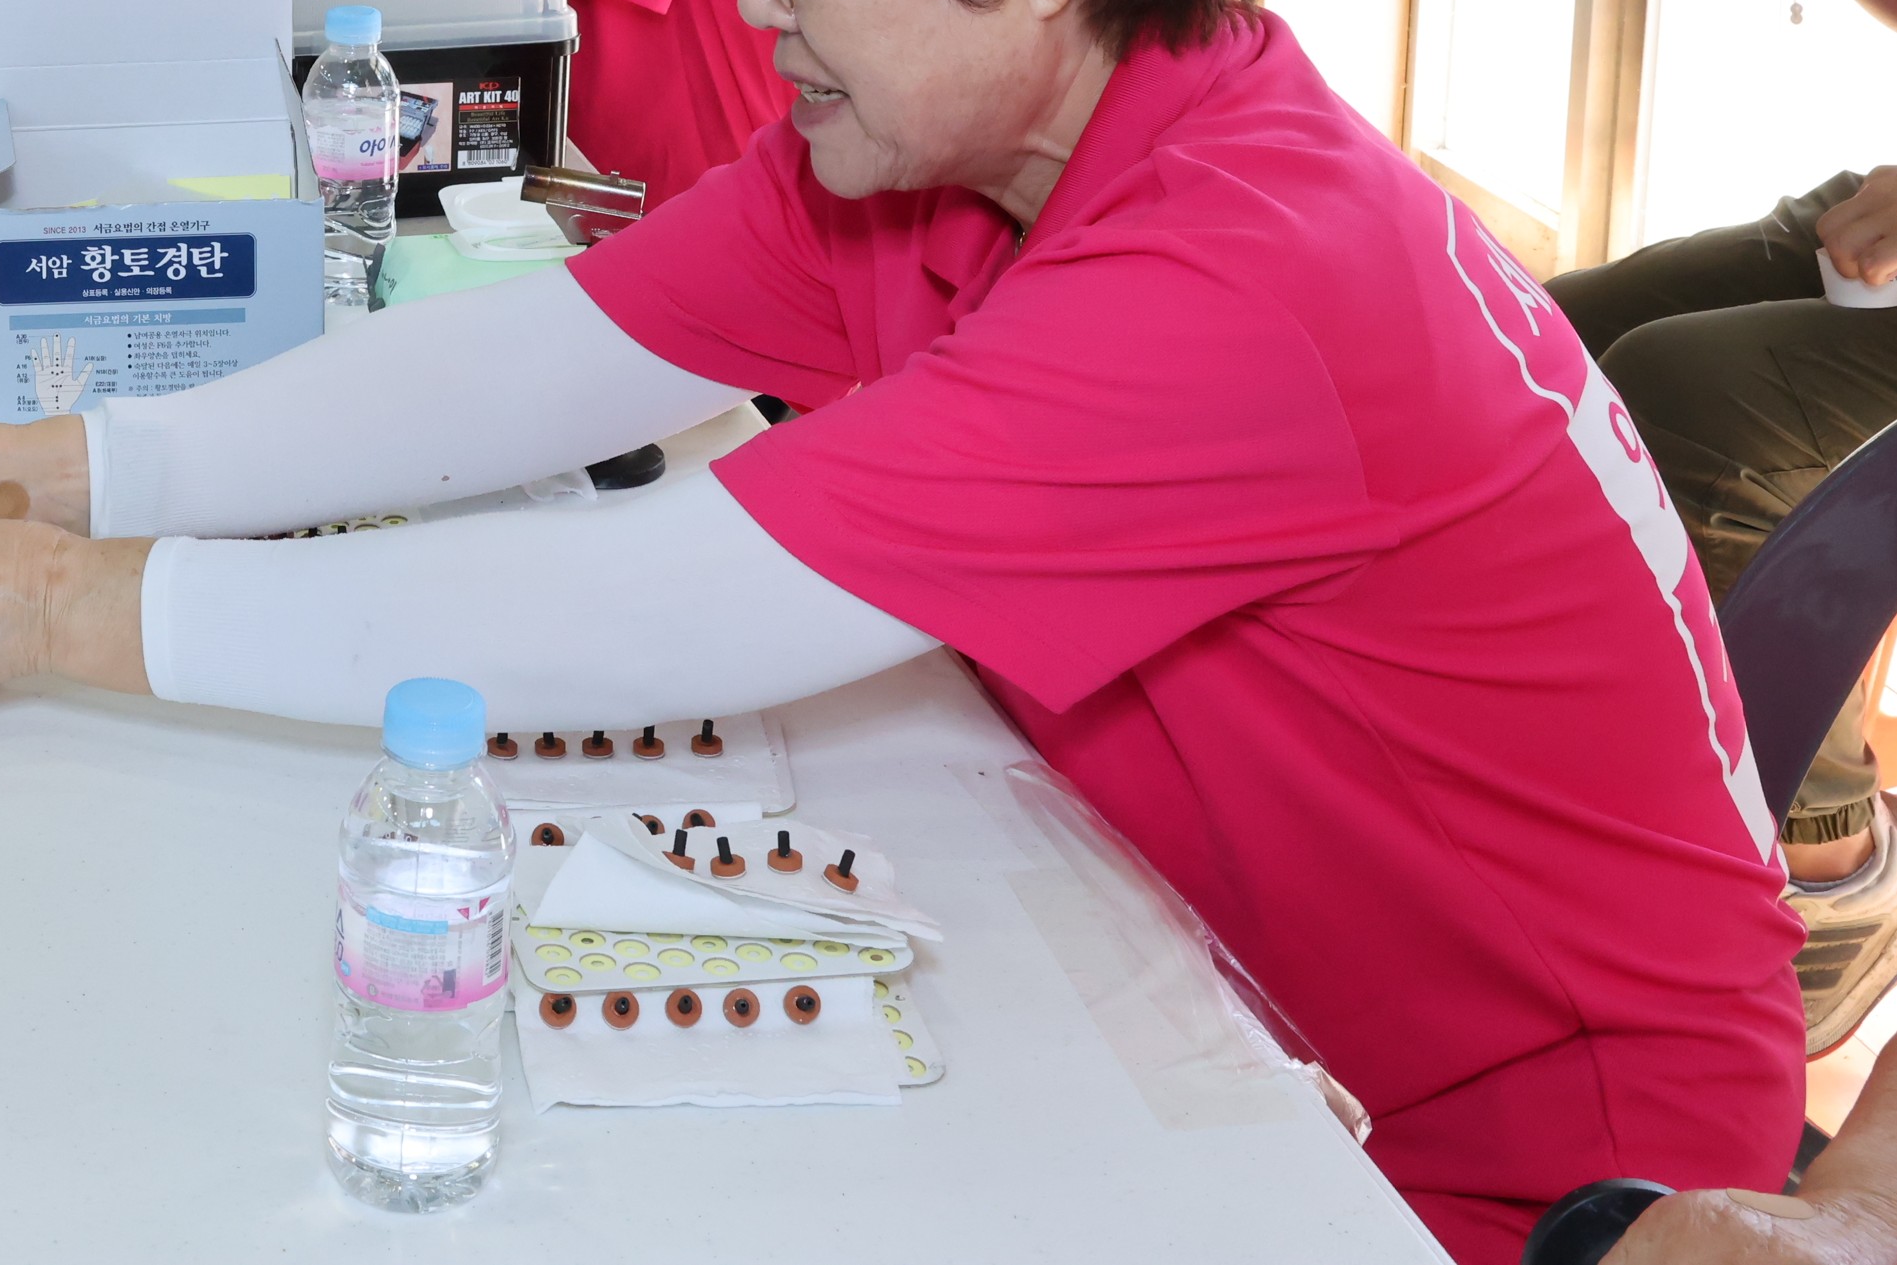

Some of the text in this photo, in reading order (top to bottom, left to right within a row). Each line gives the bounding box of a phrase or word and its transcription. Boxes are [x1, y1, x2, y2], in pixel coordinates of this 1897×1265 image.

[459, 90, 519, 104] ART KIT 40
[43, 220, 211, 235] SINCE 2013 서금요법의 간접 온열기구
[25, 241, 229, 283] 서암 황토경탄
[82, 286, 173, 298] 상표등록 실용신안 의장등록
[84, 313, 129, 326] 서금요법의
[132, 313, 151, 324] 기본
